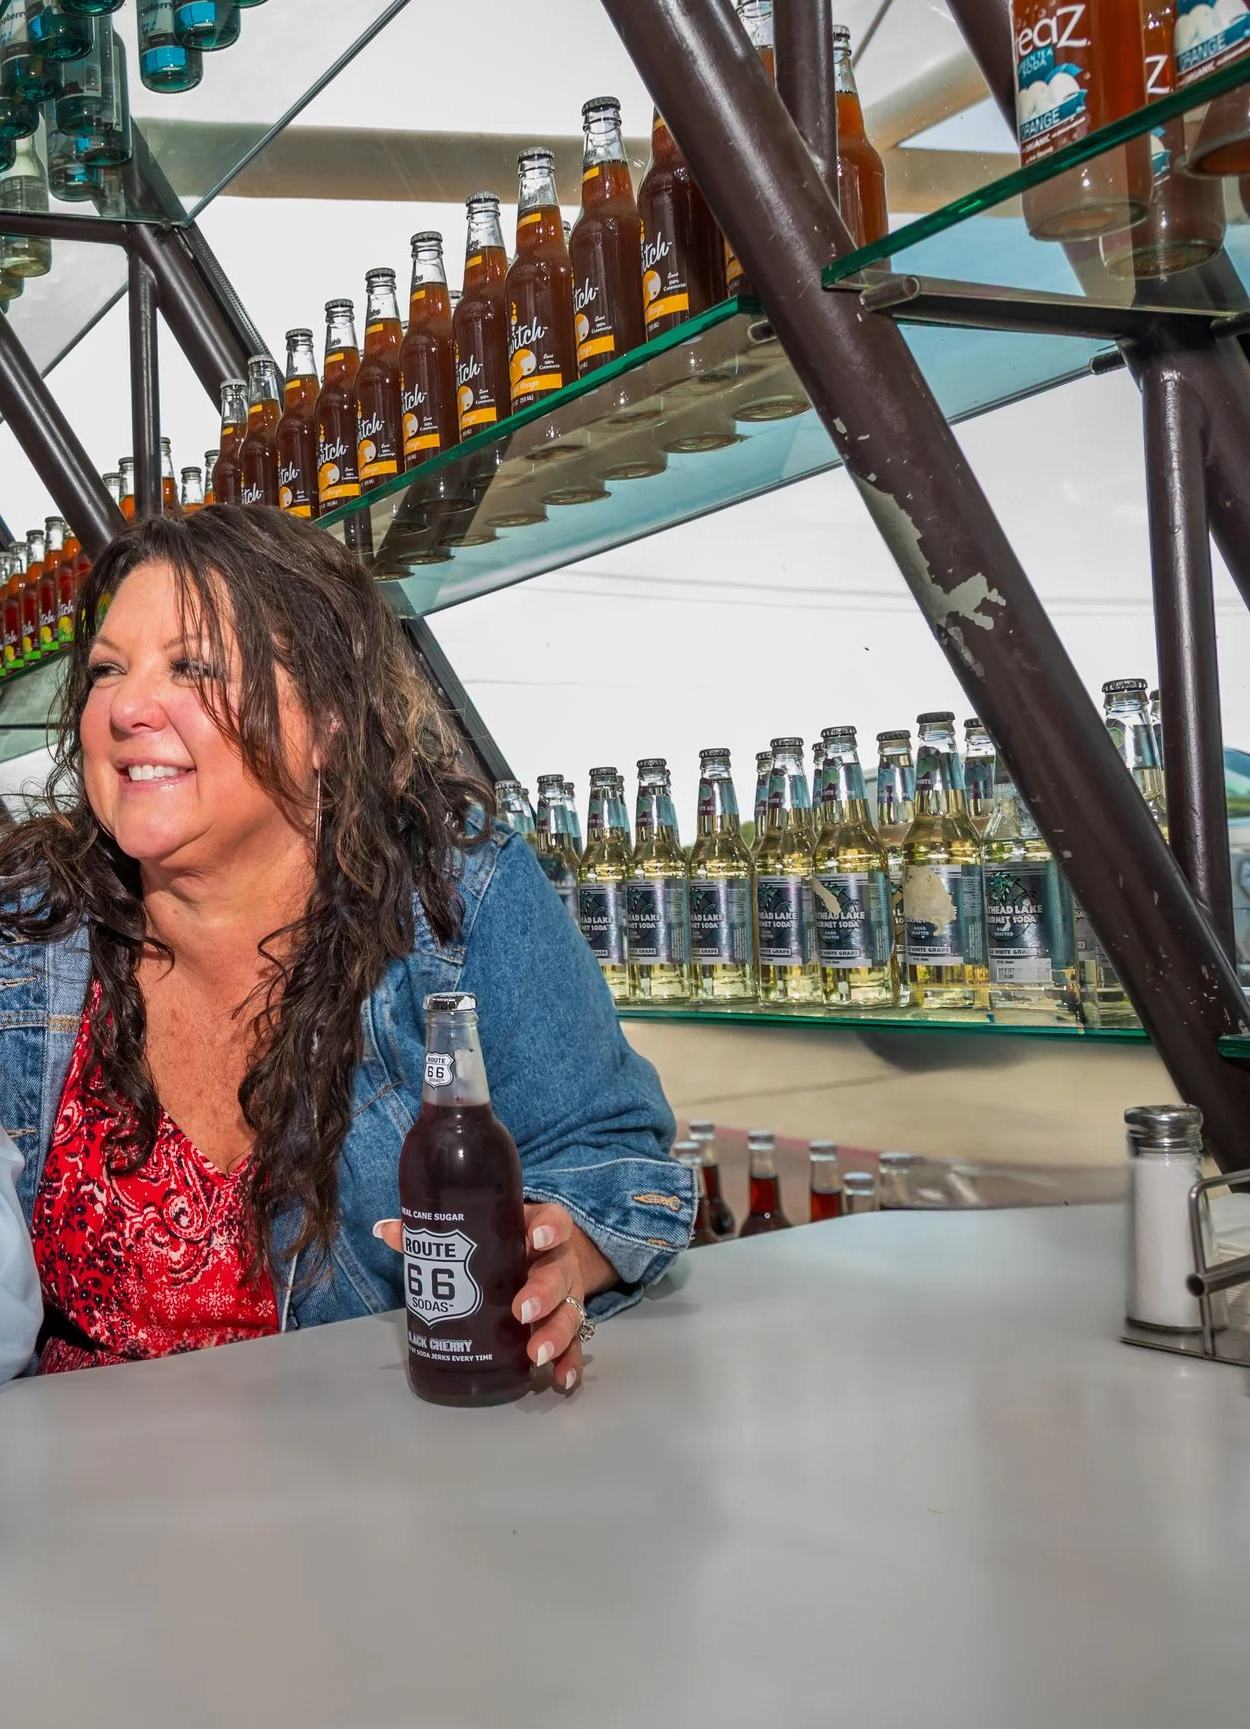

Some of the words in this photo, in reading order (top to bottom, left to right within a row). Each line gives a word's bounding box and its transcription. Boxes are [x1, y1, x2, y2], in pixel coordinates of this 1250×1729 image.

[1022, 58, 1048, 78] SODA
[1014, 904, 1043, 914] LAKE
[592, 916, 614, 924] LAKE
[640, 914, 662, 922] LAKE
[703, 914, 725, 922] LAKE
[774, 912, 797, 920] LAKE
[841, 911, 865, 920] LAKE
[1012, 915, 1037, 924] SODA
[591, 924, 608, 932] SODA
[772, 921, 791, 929] SODA
[428, 1066, 444, 1078] 66
[413, 1211, 432, 1221] CANE
[434, 1212, 465, 1222] SUGAR
[405, 1236, 456, 1258] ROUTE
[407, 1262, 456, 1301] 66
[430, 1338, 472, 1353] CHERRY
[431, 1352, 450, 1361] JERKS
[452, 1354, 474, 1362] EVERY
[475, 1353, 493, 1362] TIME
